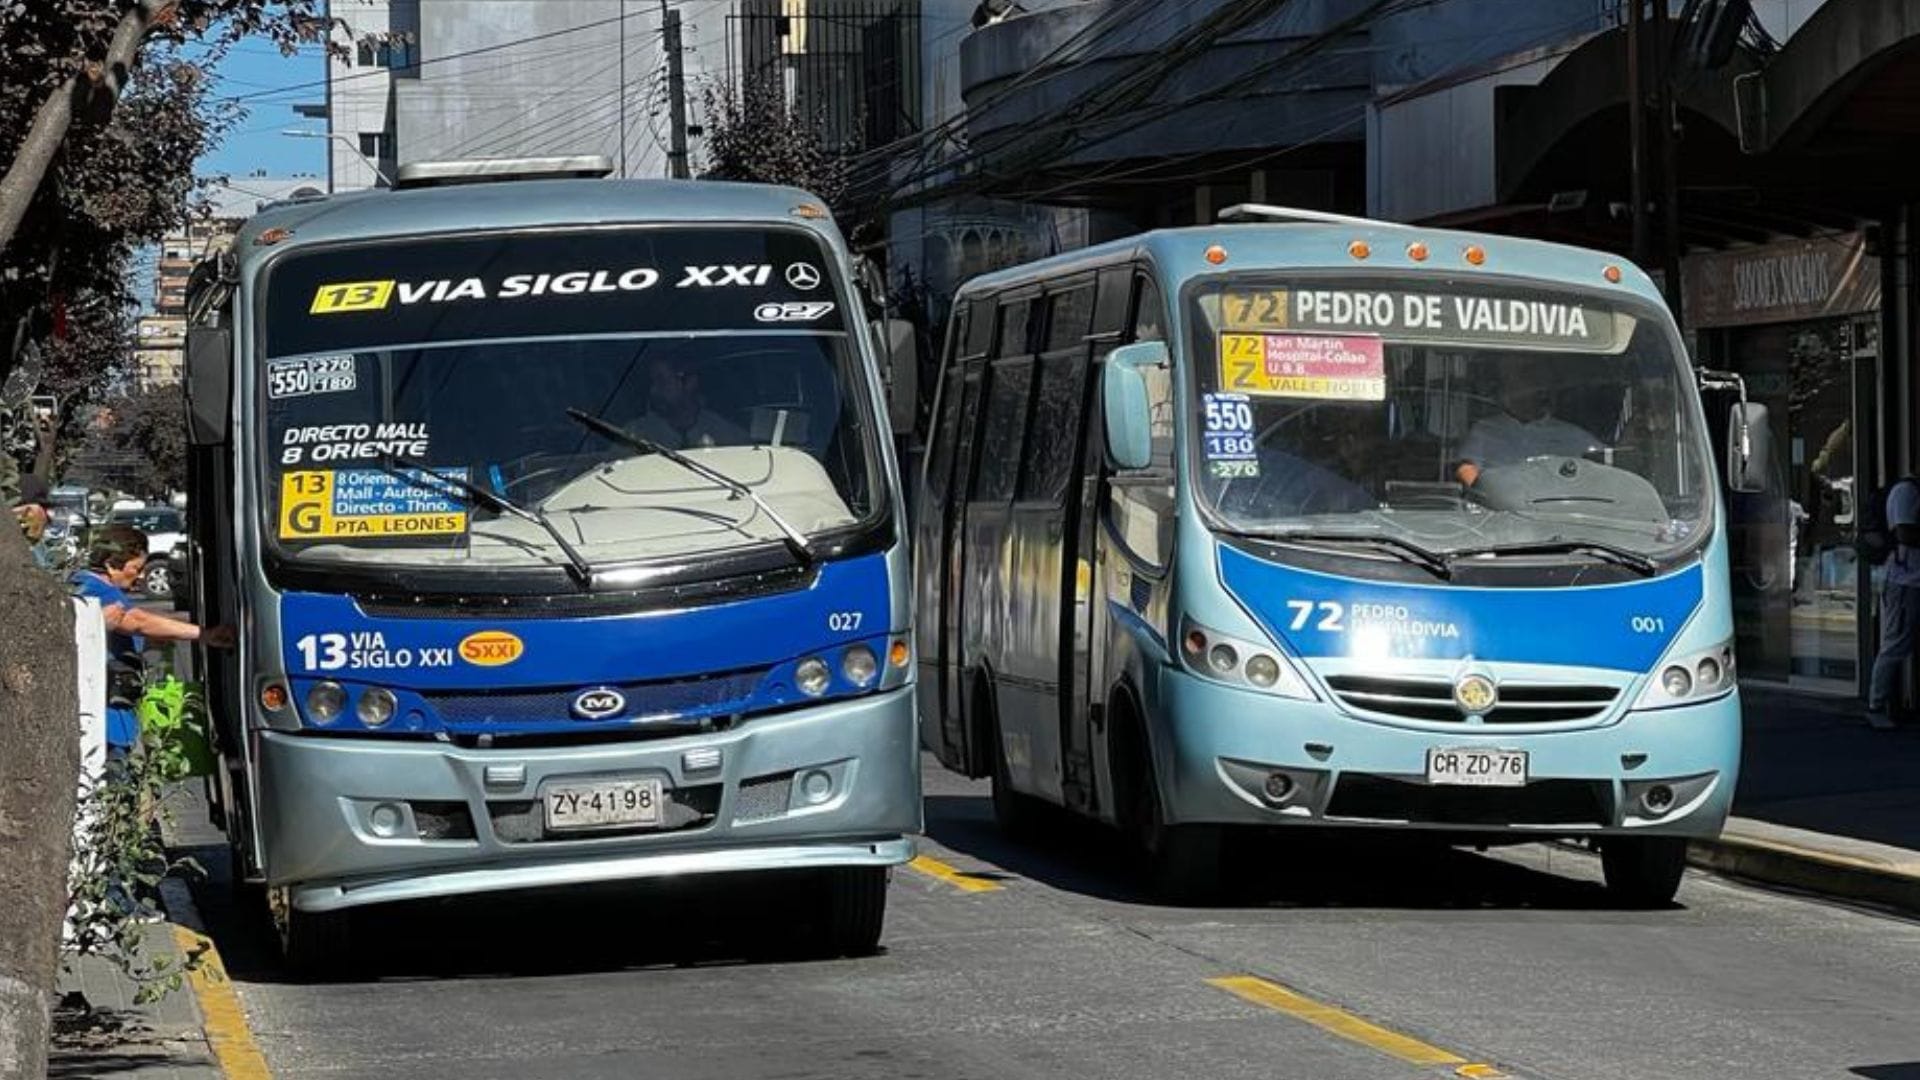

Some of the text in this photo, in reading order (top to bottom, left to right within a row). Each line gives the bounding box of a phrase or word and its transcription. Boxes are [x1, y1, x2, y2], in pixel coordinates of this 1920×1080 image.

[326, 264, 772, 307] 13 VIA SIGLO XXI
[753, 301, 835, 322] 027
[1237, 291, 1588, 337] 72 PEDRO DE VALDIVIA
[1229, 336, 1260, 355] 72
[1267, 337, 1294, 349] San
[1231, 359, 1257, 389] Z
[1269, 378, 1321, 392] VALLE
[1205, 401, 1253, 431] 550
[283, 422, 429, 445] DIRECTO MALL
[282, 440, 428, 464] 8 ORIENTE
[1209, 437, 1255, 454] 180
[290, 474, 326, 494] 13
[338, 472, 346, 485] 8
[348, 471, 399, 485] Oriente
[336, 487, 373, 501] Mall
[335, 500, 397, 515] Directo
[288, 501, 322, 534] G
[335, 516, 457, 534] PTA. LEONES
[1286, 599, 1344, 632] 72
[1351, 603, 1409, 620] PEDRO
[829, 612, 863, 631] 027
[1631, 616, 1664, 633] 001
[350, 631, 386, 649] VIA
[296, 633, 347, 671] 13
[350, 648, 453, 668] SIGLO XXI
